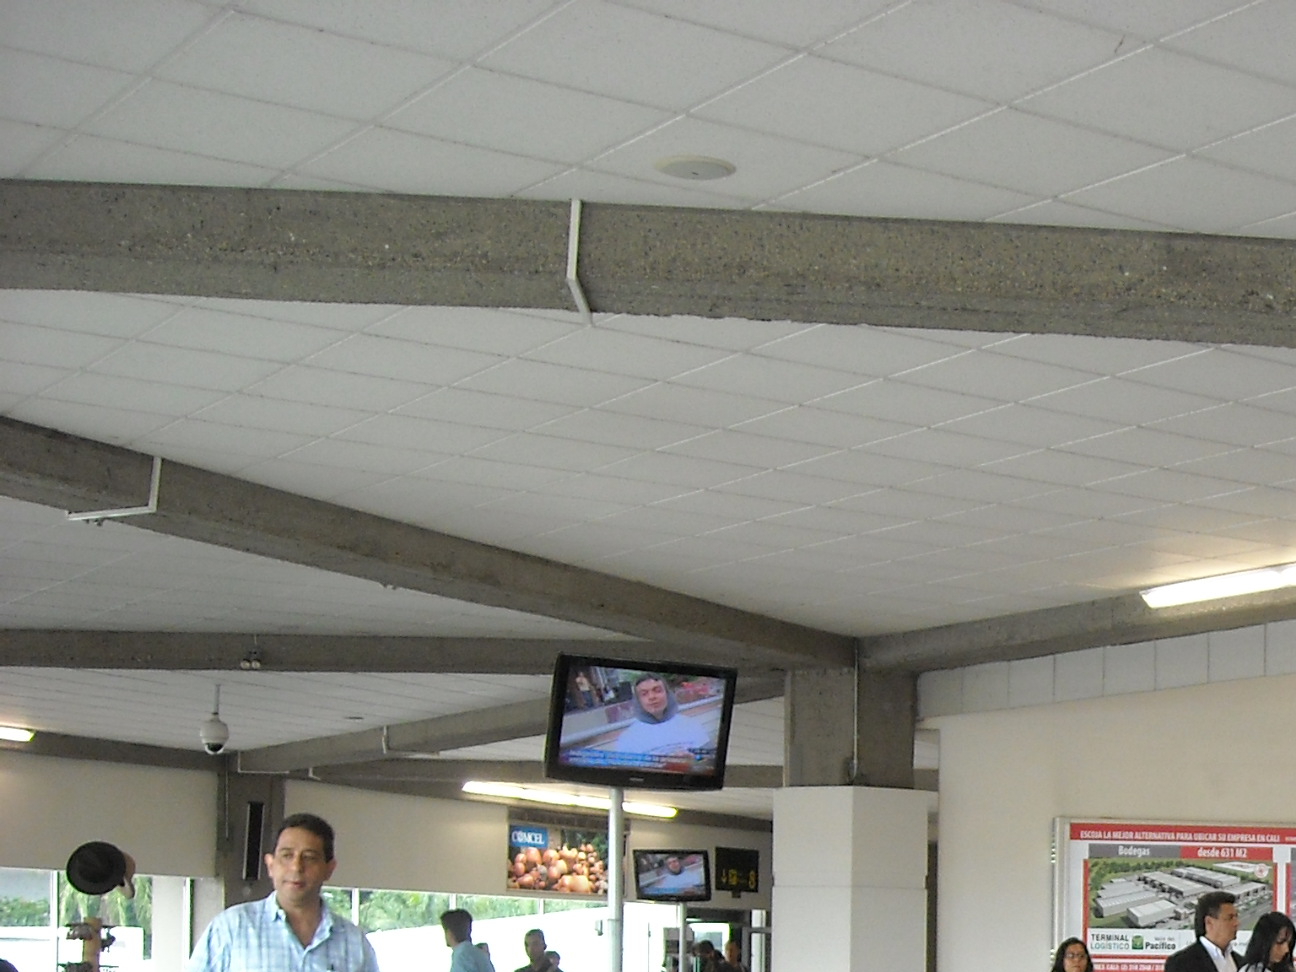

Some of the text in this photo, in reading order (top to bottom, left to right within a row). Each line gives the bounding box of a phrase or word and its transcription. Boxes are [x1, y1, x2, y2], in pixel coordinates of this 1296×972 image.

[511, 830, 545, 845] COMCEL
[1080, 830, 1102, 839] ESCOJA
[1103, 830, 1111, 839] LA
[1112, 830, 1134, 840] MEJOR
[1134, 831, 1175, 840] ALTERNATIVA
[1176, 832, 1193, 841] PARA
[1193, 832, 1216, 841] UBICAR
[1218, 833, 1226, 842] SU
[1227, 833, 1255, 842] EMPRESA
[1257, 834, 1266, 842] EN
[1266, 834, 1280, 843] CALI
[1118, 845, 1150, 858] Bodegas
[1197, 847, 1247, 858] desde 631 M2
[1091, 933, 1129, 942] TERMINAL
